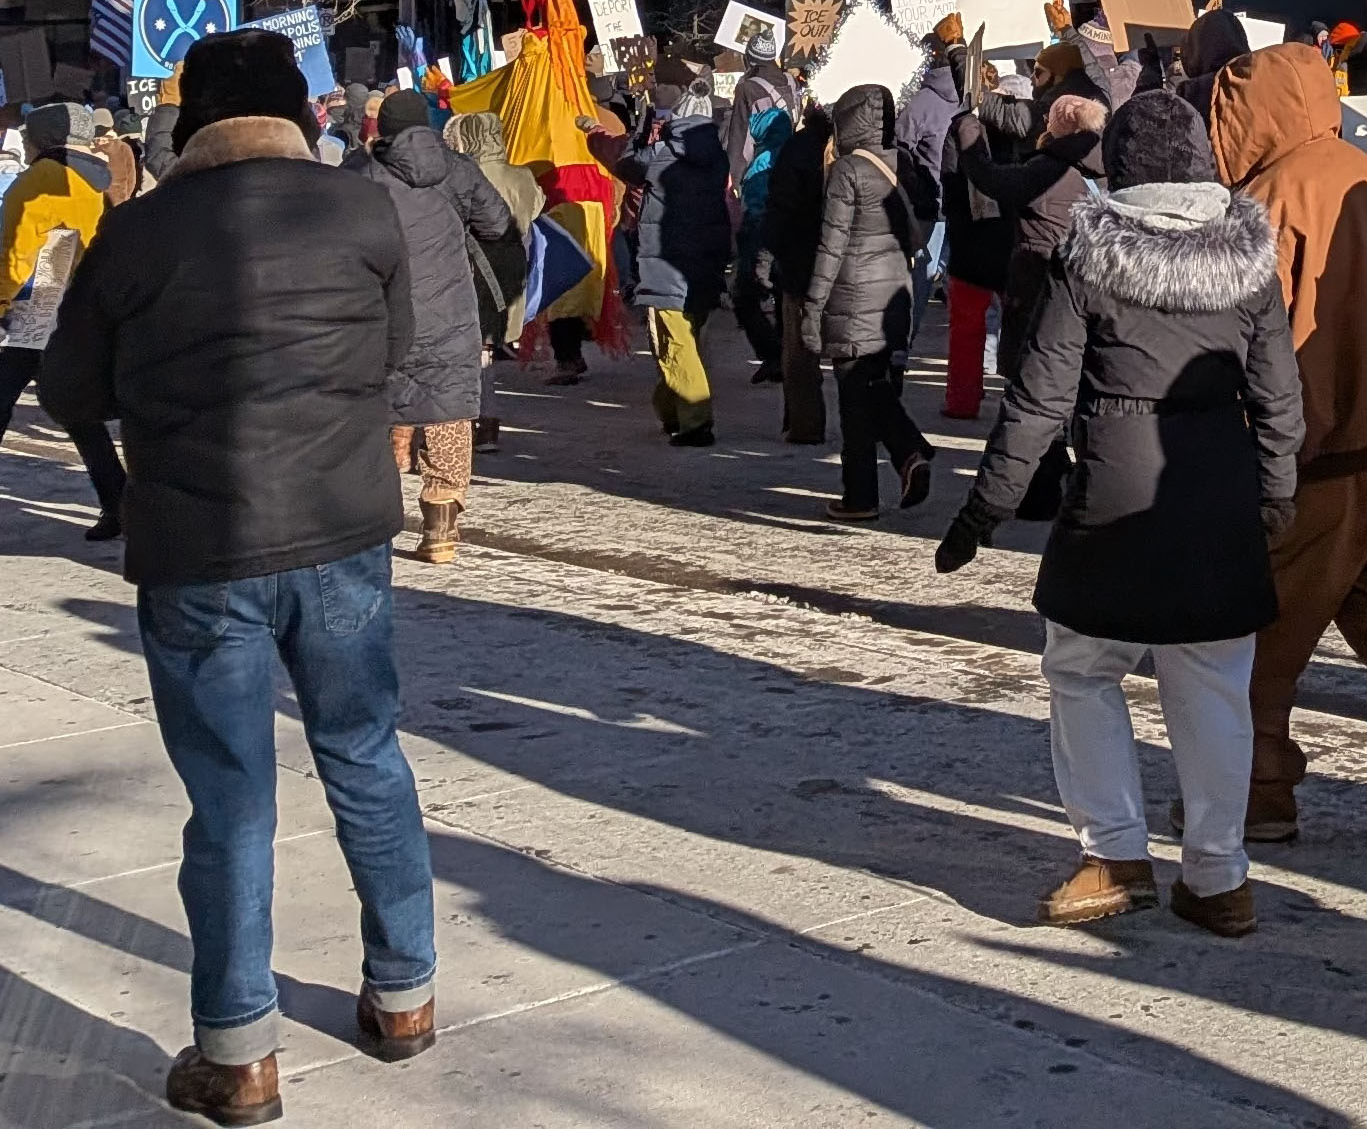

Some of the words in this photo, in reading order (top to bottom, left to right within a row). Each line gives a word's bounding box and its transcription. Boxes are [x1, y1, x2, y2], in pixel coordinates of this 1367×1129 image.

[263, 9, 314, 31] MORNING
[801, 10, 828, 23] ICE
[898, 6, 928, 23] YOUR
[800, 25, 830, 37] OUT!
[292, 34, 320, 49] NING
[127, 79, 157, 95] ICE
